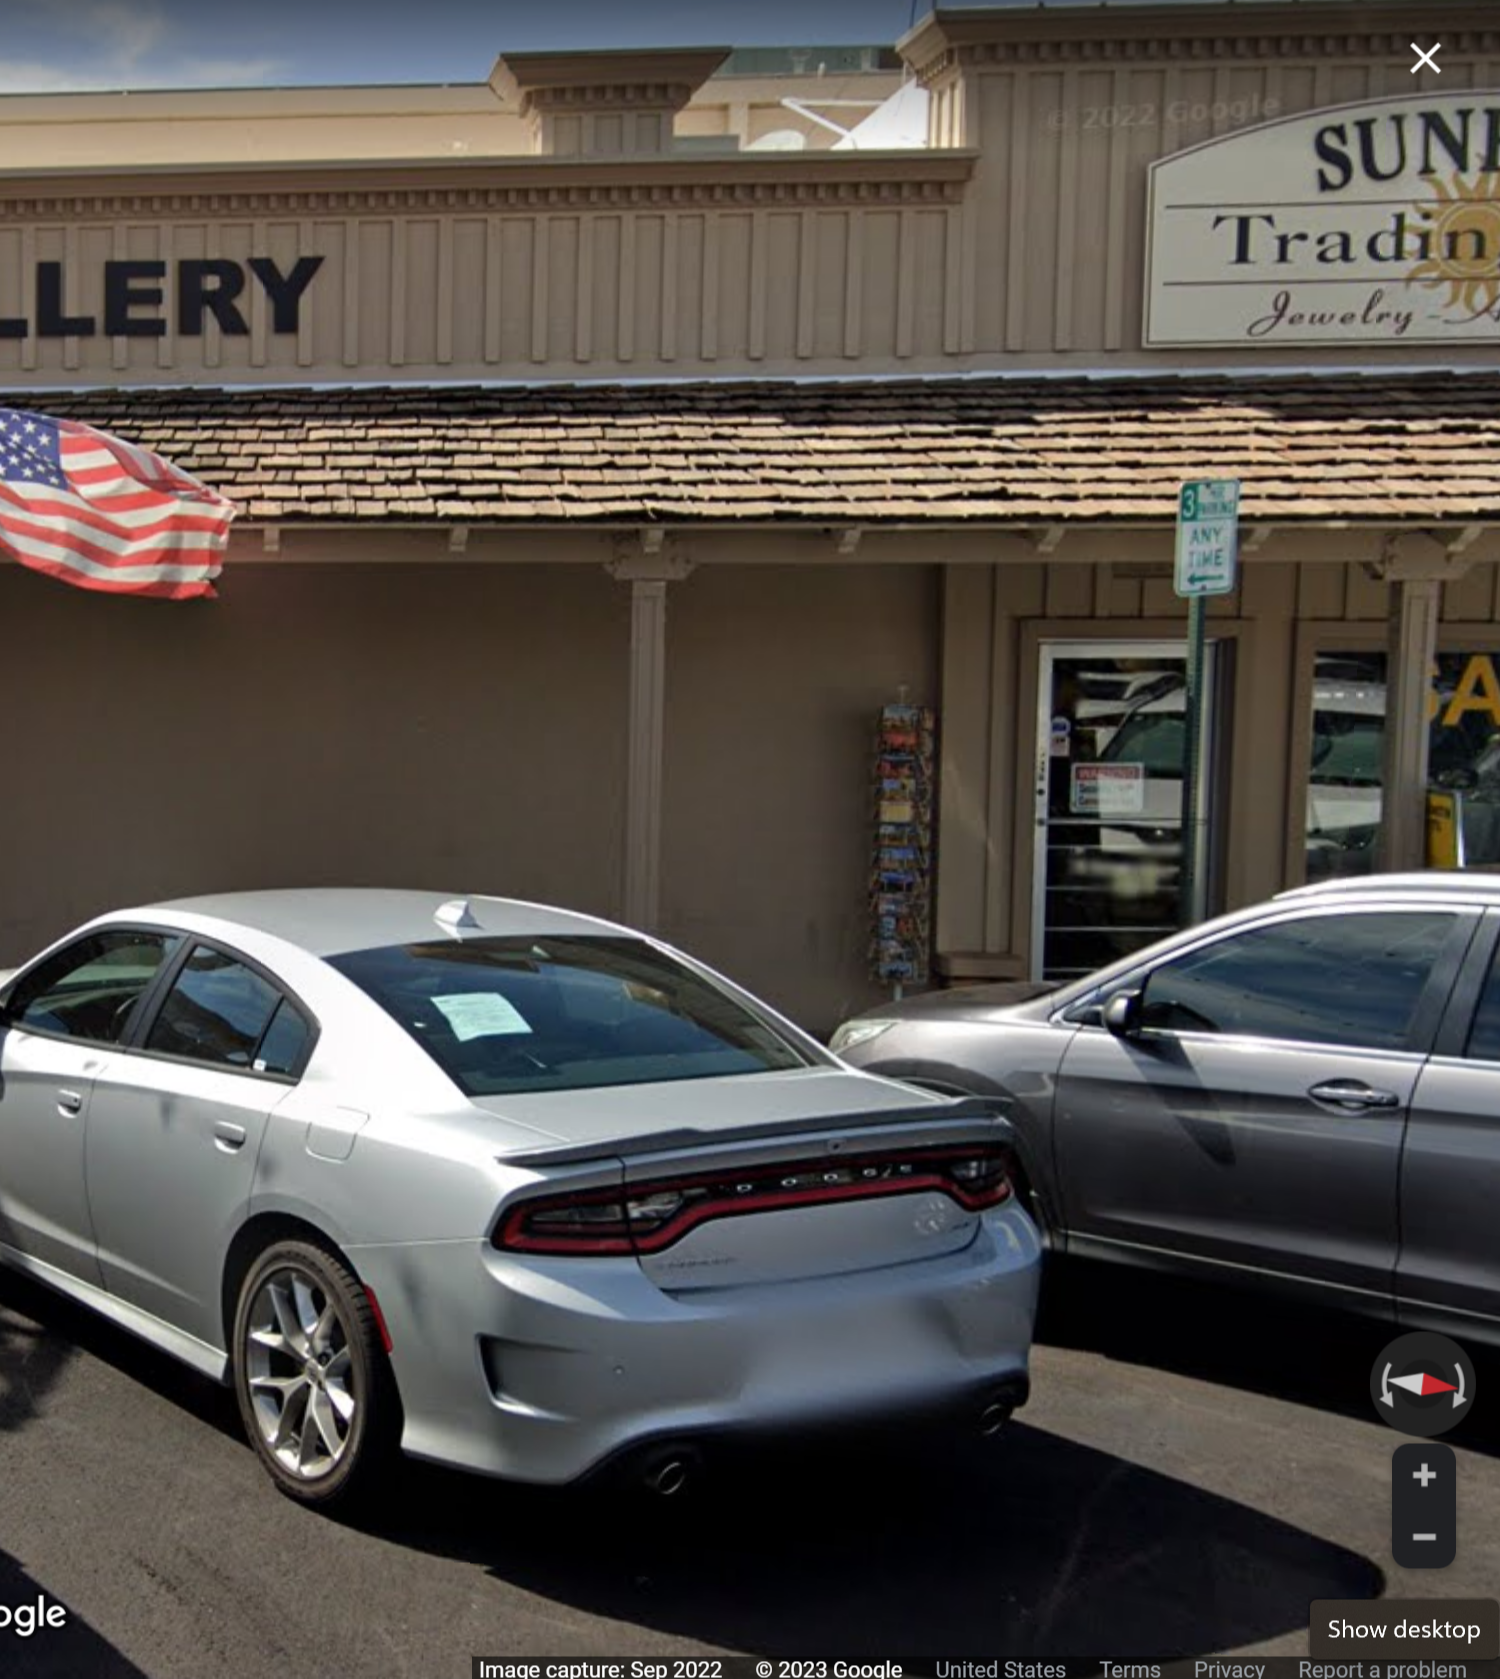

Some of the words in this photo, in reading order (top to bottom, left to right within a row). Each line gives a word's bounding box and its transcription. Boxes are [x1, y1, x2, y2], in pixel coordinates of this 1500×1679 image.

[1213, 212, 1500, 267] Tradin
[1247, 291, 1414, 336] Jewelry
[1182, 489, 1196, 518] 3
[1191, 528, 1221, 544] ANY
[1188, 549, 1223, 568] TIME
